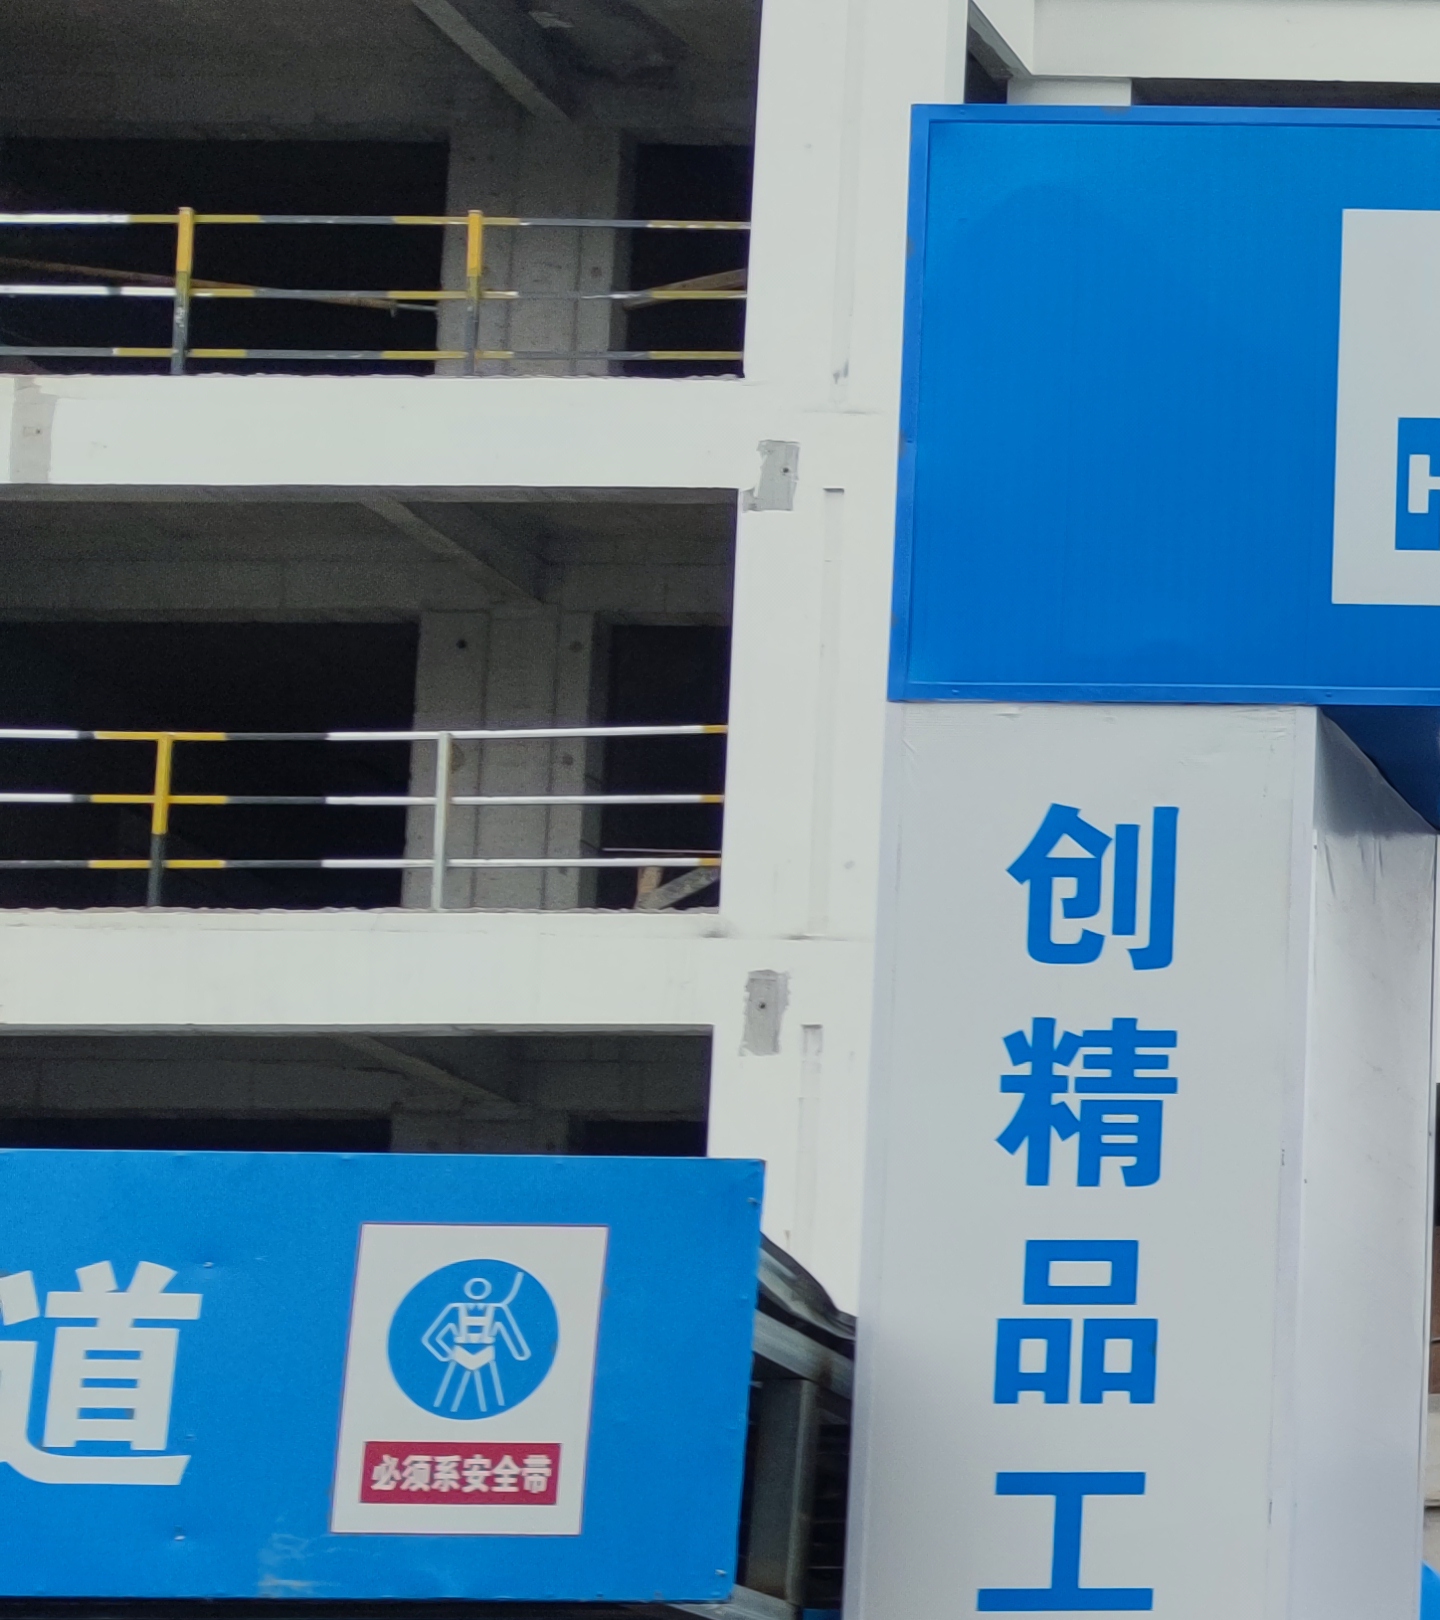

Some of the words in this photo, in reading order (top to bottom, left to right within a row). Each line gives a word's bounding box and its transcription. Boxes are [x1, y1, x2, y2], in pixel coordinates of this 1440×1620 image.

[0, 1260, 204, 1487] 道
[370, 1453, 553, 1494] 必须系安全带
